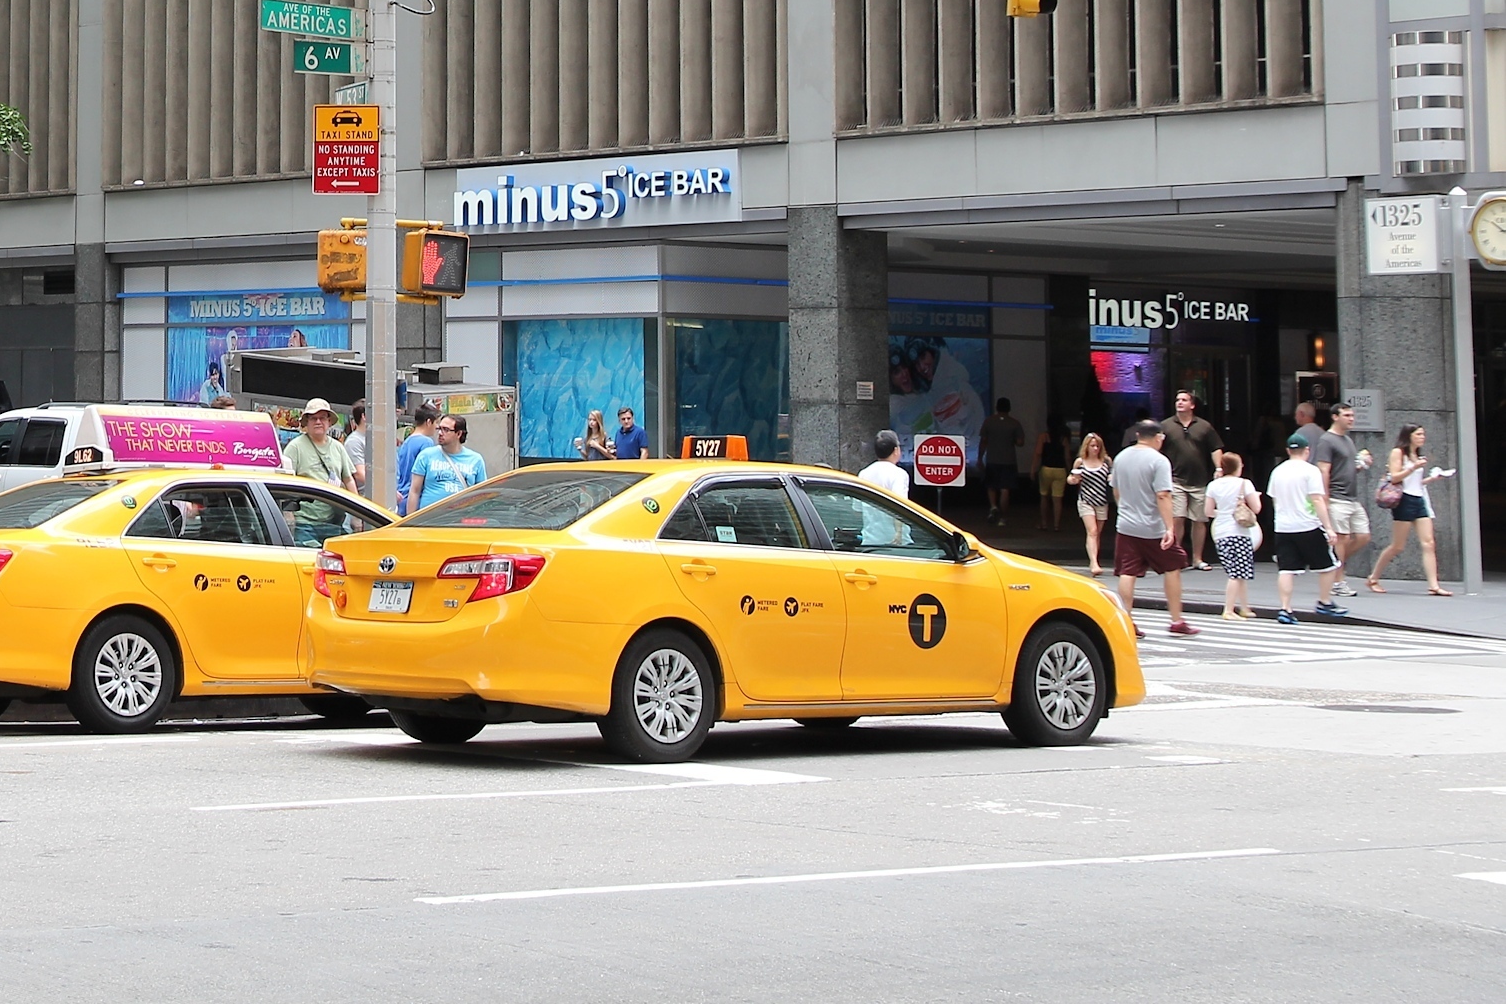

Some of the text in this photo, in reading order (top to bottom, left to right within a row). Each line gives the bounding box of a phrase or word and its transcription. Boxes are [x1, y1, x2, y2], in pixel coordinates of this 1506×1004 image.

[283, 3, 331, 17] AVE OF THE
[267, 11, 347, 35] AMERICAS
[304, 45, 341, 70] 6 AV
[358, 86, 365, 99] ST
[321, 131, 373, 139] TAXI STAND
[318, 145, 374, 154] NO STANDING
[327, 157, 366, 166] ANYTIME
[317, 168, 376, 177] EXCEPT TAXIS
[628, 171, 666, 198] ICE
[673, 167, 726, 195] BAR
[1379, 203, 1422, 227] 1325
[1388, 232, 1416, 241] Avenue
[1392, 245, 1414, 255] of the
[1385, 259, 1422, 268] Americas
[190, 300, 241, 318] MINUS
[258, 298, 287, 317] ICE
[290, 297, 326, 315] BAR
[1184, 301, 1211, 319] ICE
[1215, 302, 1249, 322] BAR
[930, 313, 954, 326] ICE
[957, 314, 986, 328] BAR
[107, 421, 192, 438] THE SHOW
[125, 439, 228, 455] THAT NEVER ENDS.
[233, 442, 275, 461] Borgata
[696, 440, 720, 456] 5Y27
[922, 445, 957, 454] DO NOT
[74, 449, 92, 463] 9L62
[925, 467, 953, 476] ENTER
[444, 482, 459, 493] USA
[888, 604, 938, 642] NYC T
